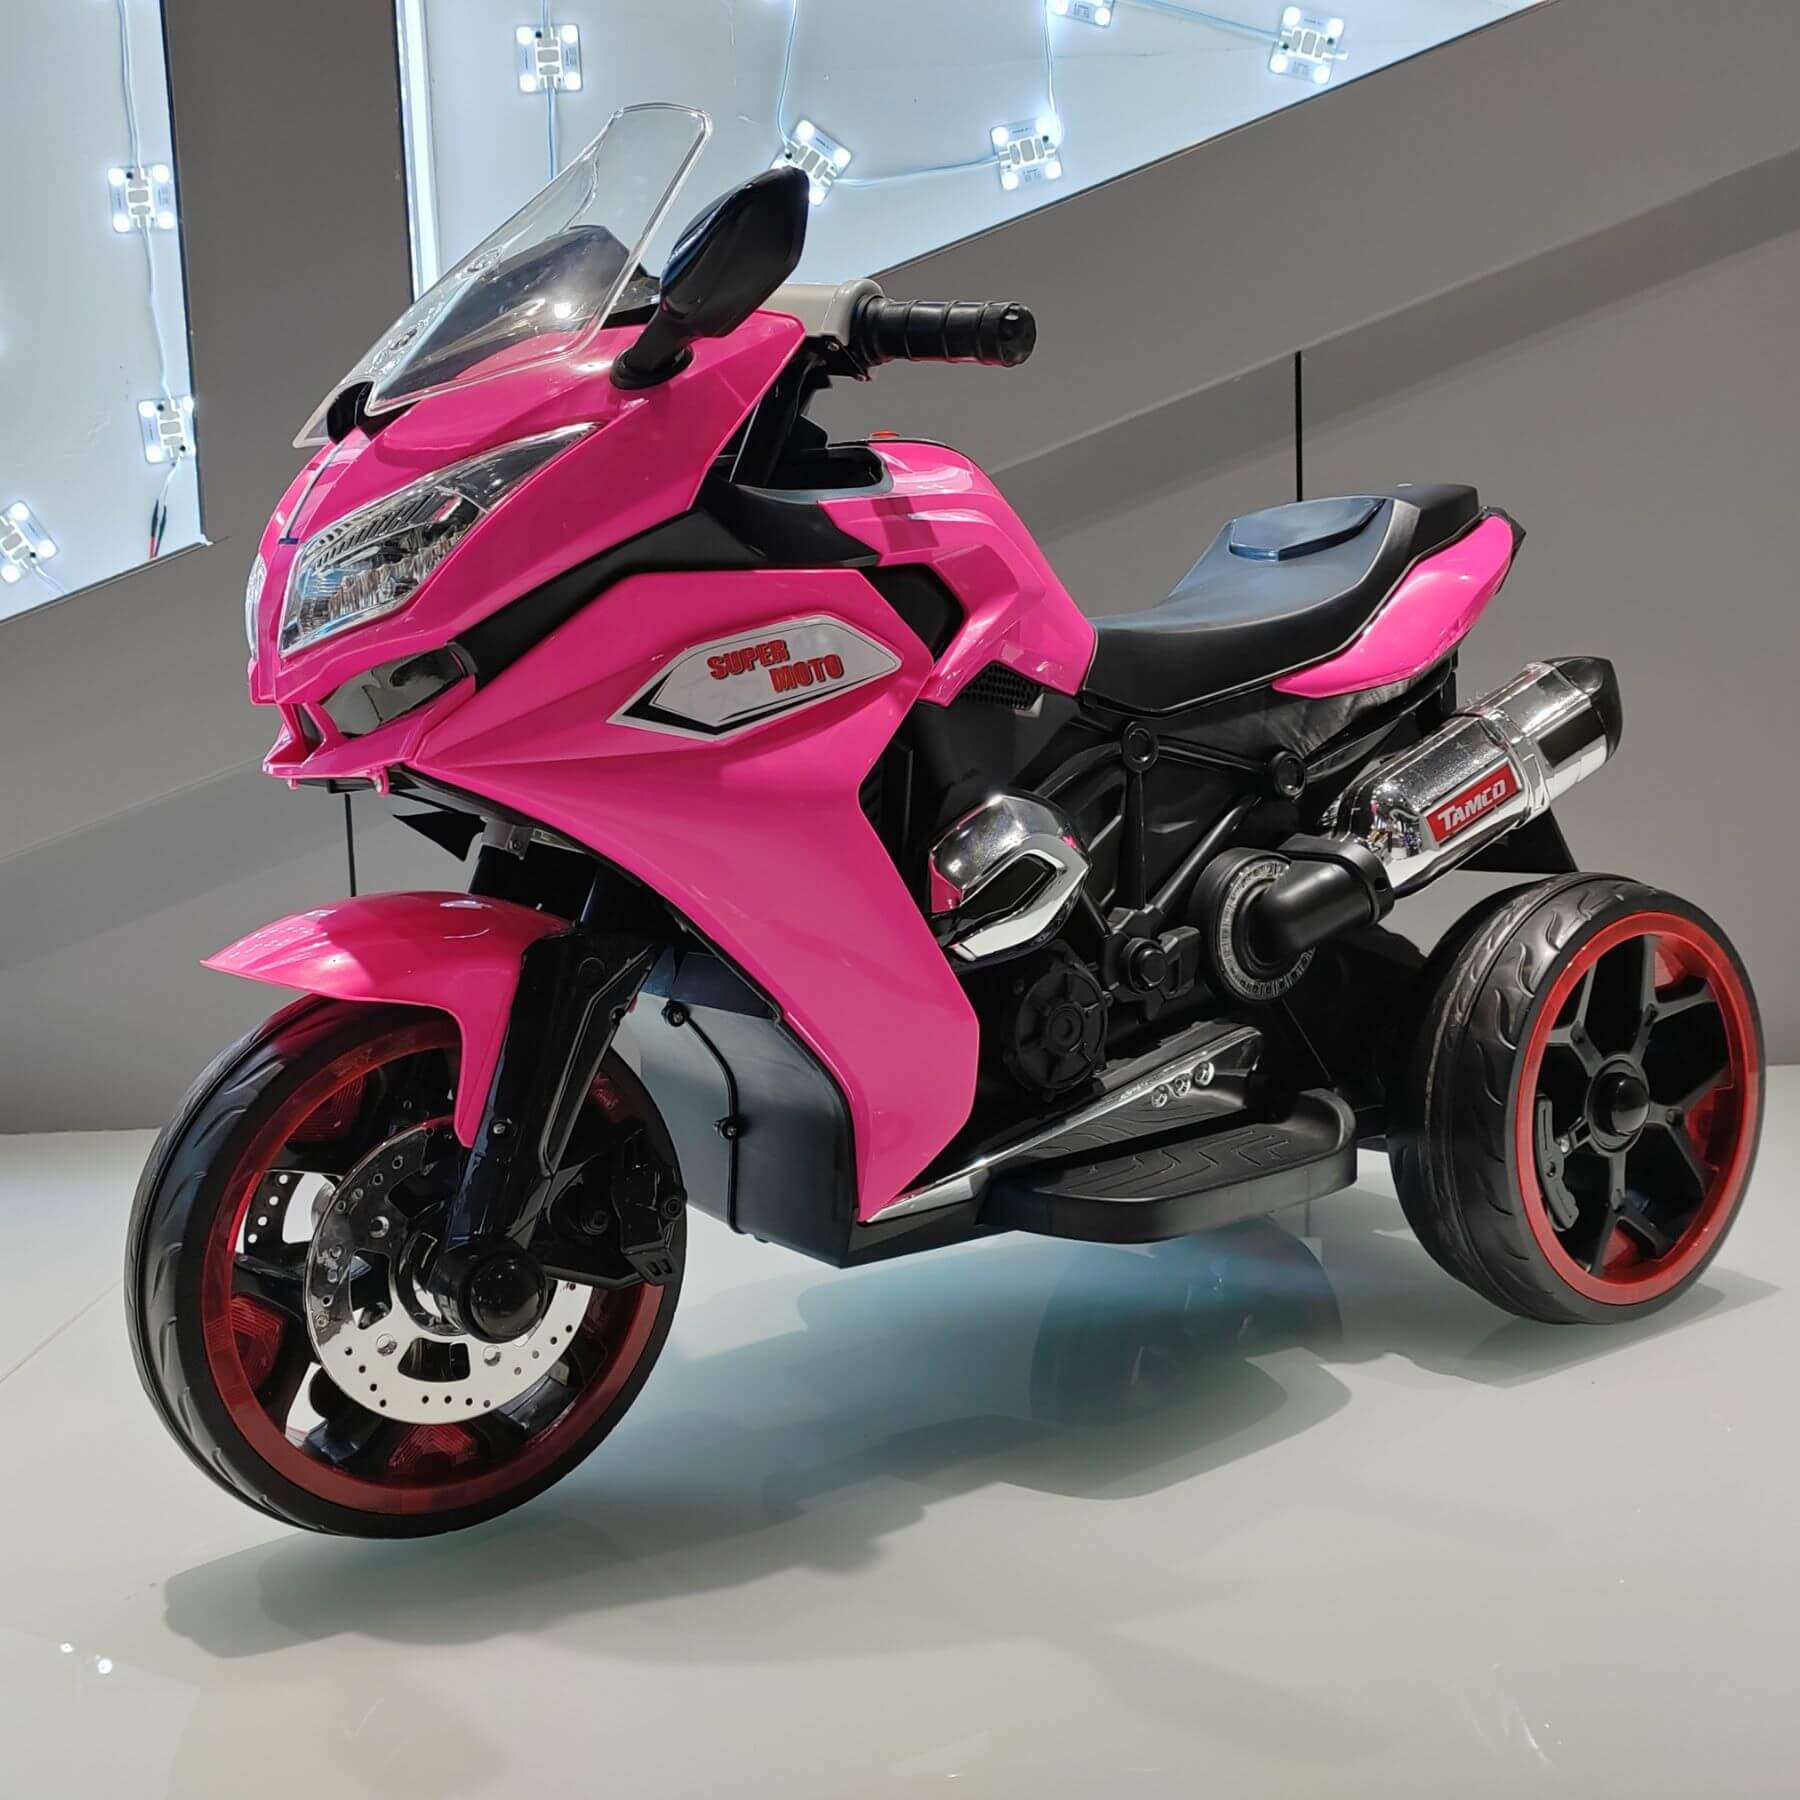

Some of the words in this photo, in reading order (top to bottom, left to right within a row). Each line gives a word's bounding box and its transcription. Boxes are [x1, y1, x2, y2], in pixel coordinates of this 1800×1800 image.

[706, 639, 791, 680] SUPER
[769, 654, 844, 693] MOTO
[1437, 779, 1507, 832] TAMCO
